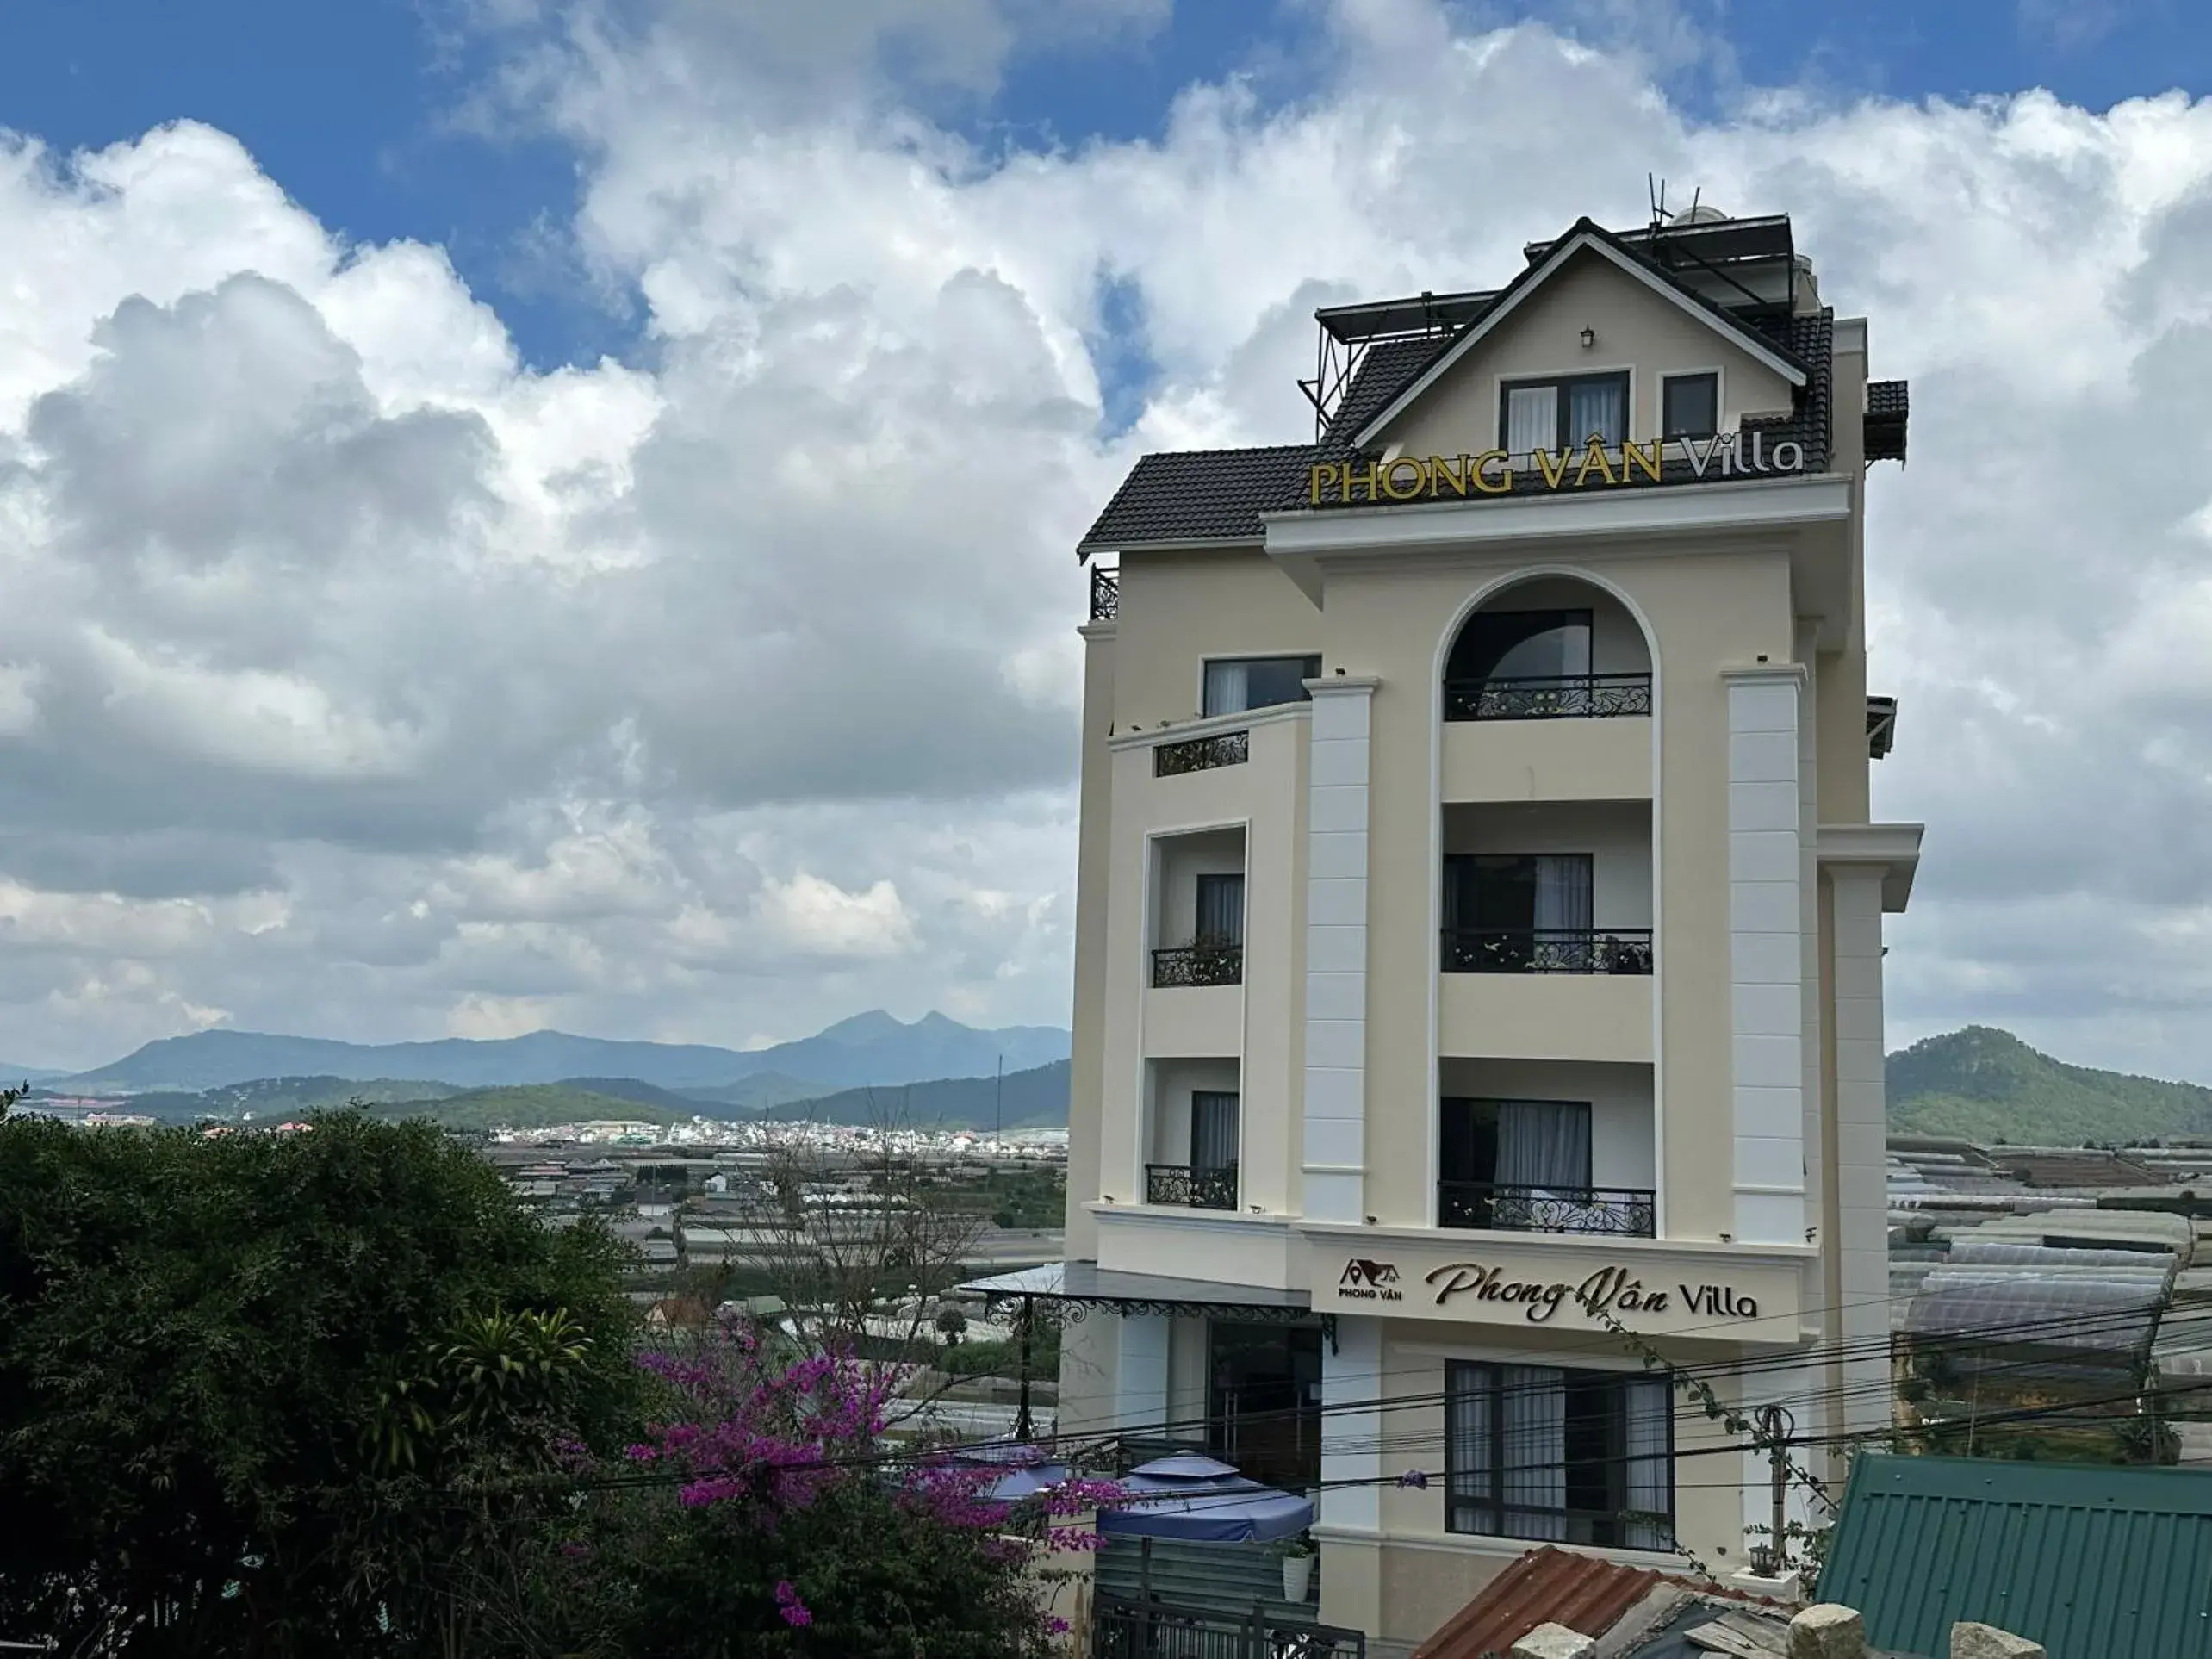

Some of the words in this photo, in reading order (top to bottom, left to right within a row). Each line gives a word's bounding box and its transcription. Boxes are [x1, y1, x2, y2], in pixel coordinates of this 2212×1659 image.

[1310, 449, 1513, 504] PHONG
[1534, 432, 1663, 489] VÂN
[1680, 431, 1805, 477] Villa
[1338, 1288, 1376, 1299] PHONG
[1380, 1288, 1402, 1301] VÂN
[1425, 1263, 1567, 1322] Phong
[1576, 1265, 1669, 1314] Vân
[1678, 1284, 1757, 1318] Villa
